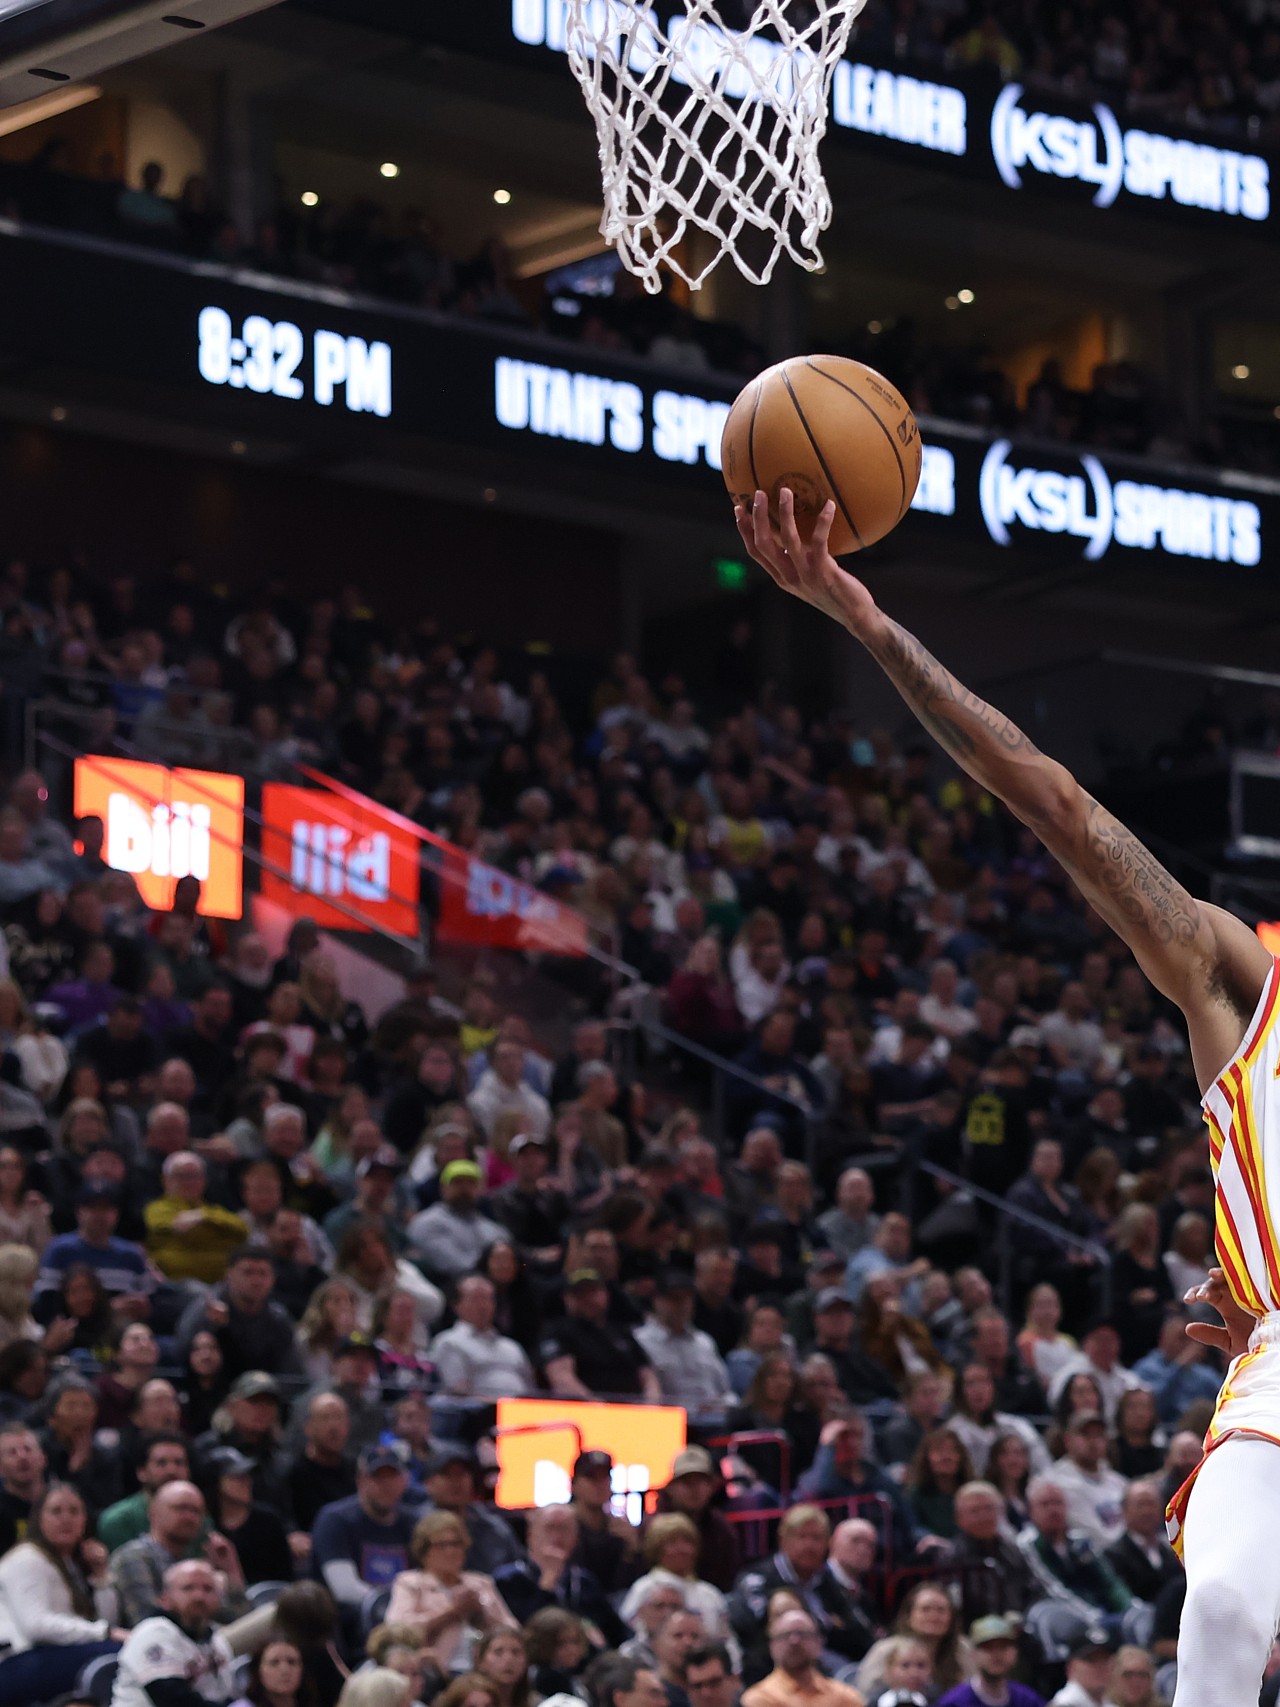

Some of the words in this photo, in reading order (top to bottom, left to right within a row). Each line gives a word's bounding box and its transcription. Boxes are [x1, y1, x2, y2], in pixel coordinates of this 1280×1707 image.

[833, 59, 966, 156] LEADER
[1124, 129, 1270, 221] SPORTS
[198, 306, 304, 399] 8:32
[314, 329, 392, 418] PM
[495, 356, 643, 453] UTAH'S
[1114, 480, 1261, 567] SPORTS
